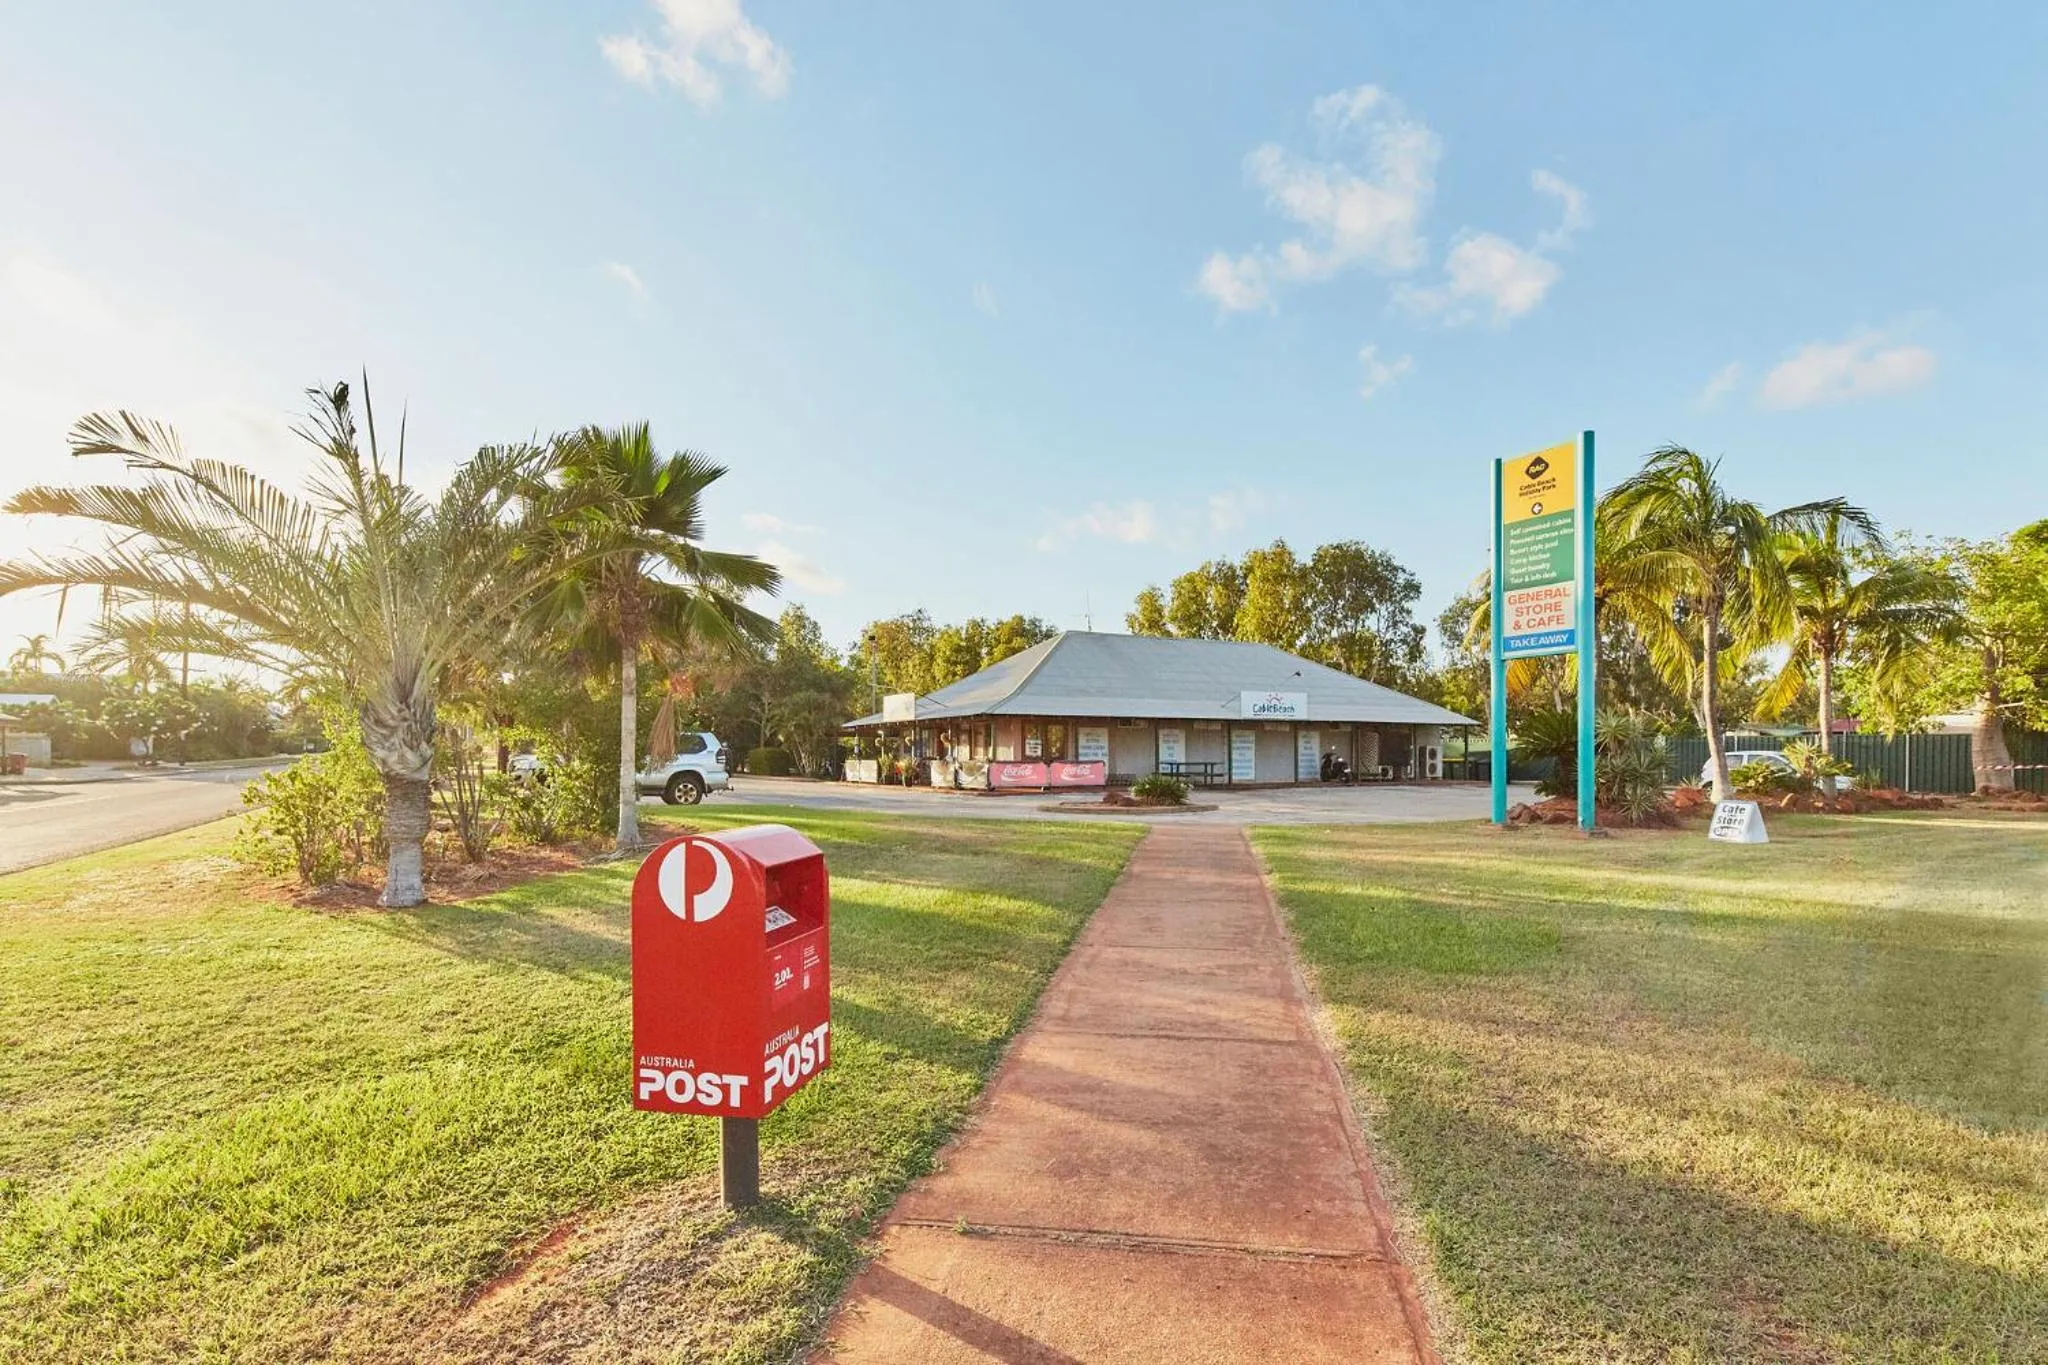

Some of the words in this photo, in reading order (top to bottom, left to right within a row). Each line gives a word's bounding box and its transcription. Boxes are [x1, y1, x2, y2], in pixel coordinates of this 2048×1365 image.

[1508, 587, 1571, 605] GENERAL
[1515, 601, 1562, 617] STORE
[1513, 620, 1521, 631] &
[1527, 613, 1565, 629] CAFE
[1510, 633, 1568, 648] TAKEAWAY
[1722, 804, 1746, 814] Cafe
[764, 1024, 800, 1057] AUSTRALIA
[639, 1056, 695, 1069] AUSTRALIA
[764, 1021, 829, 1104] POST
[639, 1068, 749, 1108] POST
